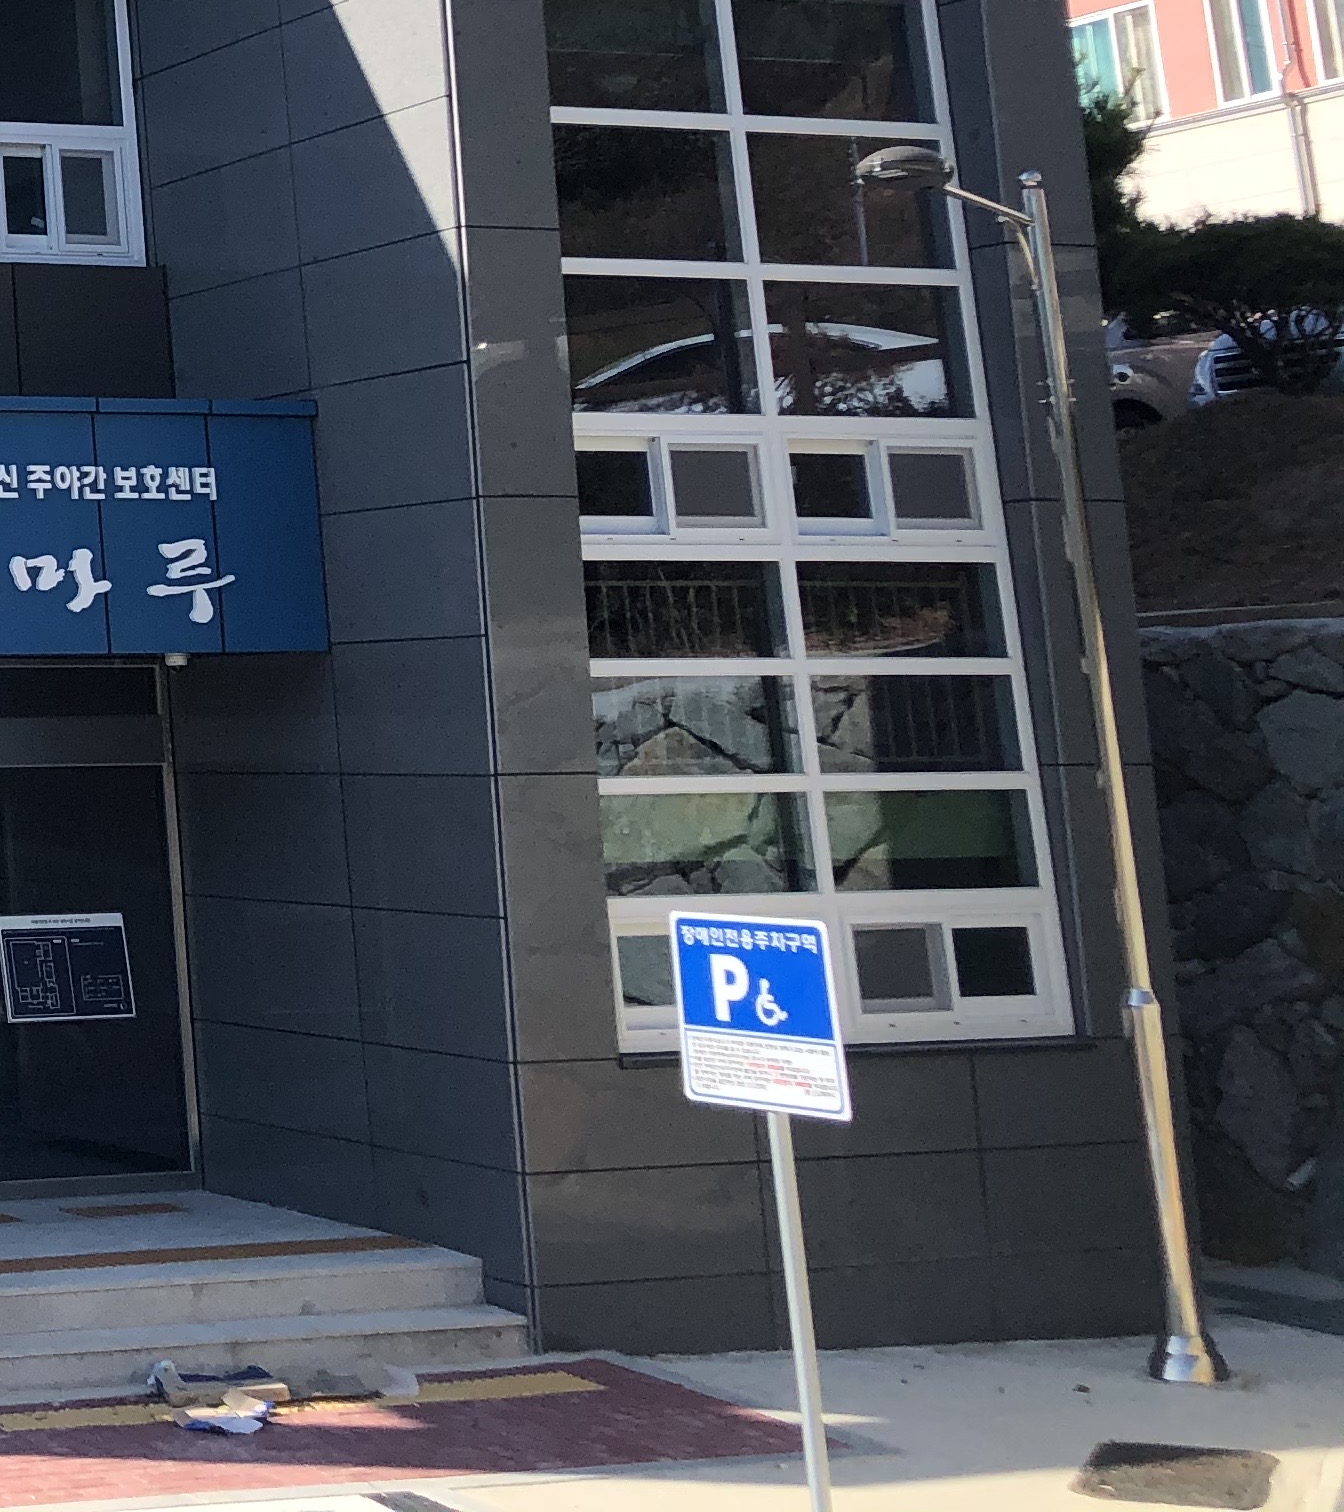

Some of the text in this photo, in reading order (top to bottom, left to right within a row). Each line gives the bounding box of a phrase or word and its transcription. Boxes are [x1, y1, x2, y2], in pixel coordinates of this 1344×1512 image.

[26, 464, 107, 500] 주야간
[113, 465, 218, 501] 보호센터
[679, 924, 818, 954] 장애인전용주차구역
[709, 953, 750, 1023] P
